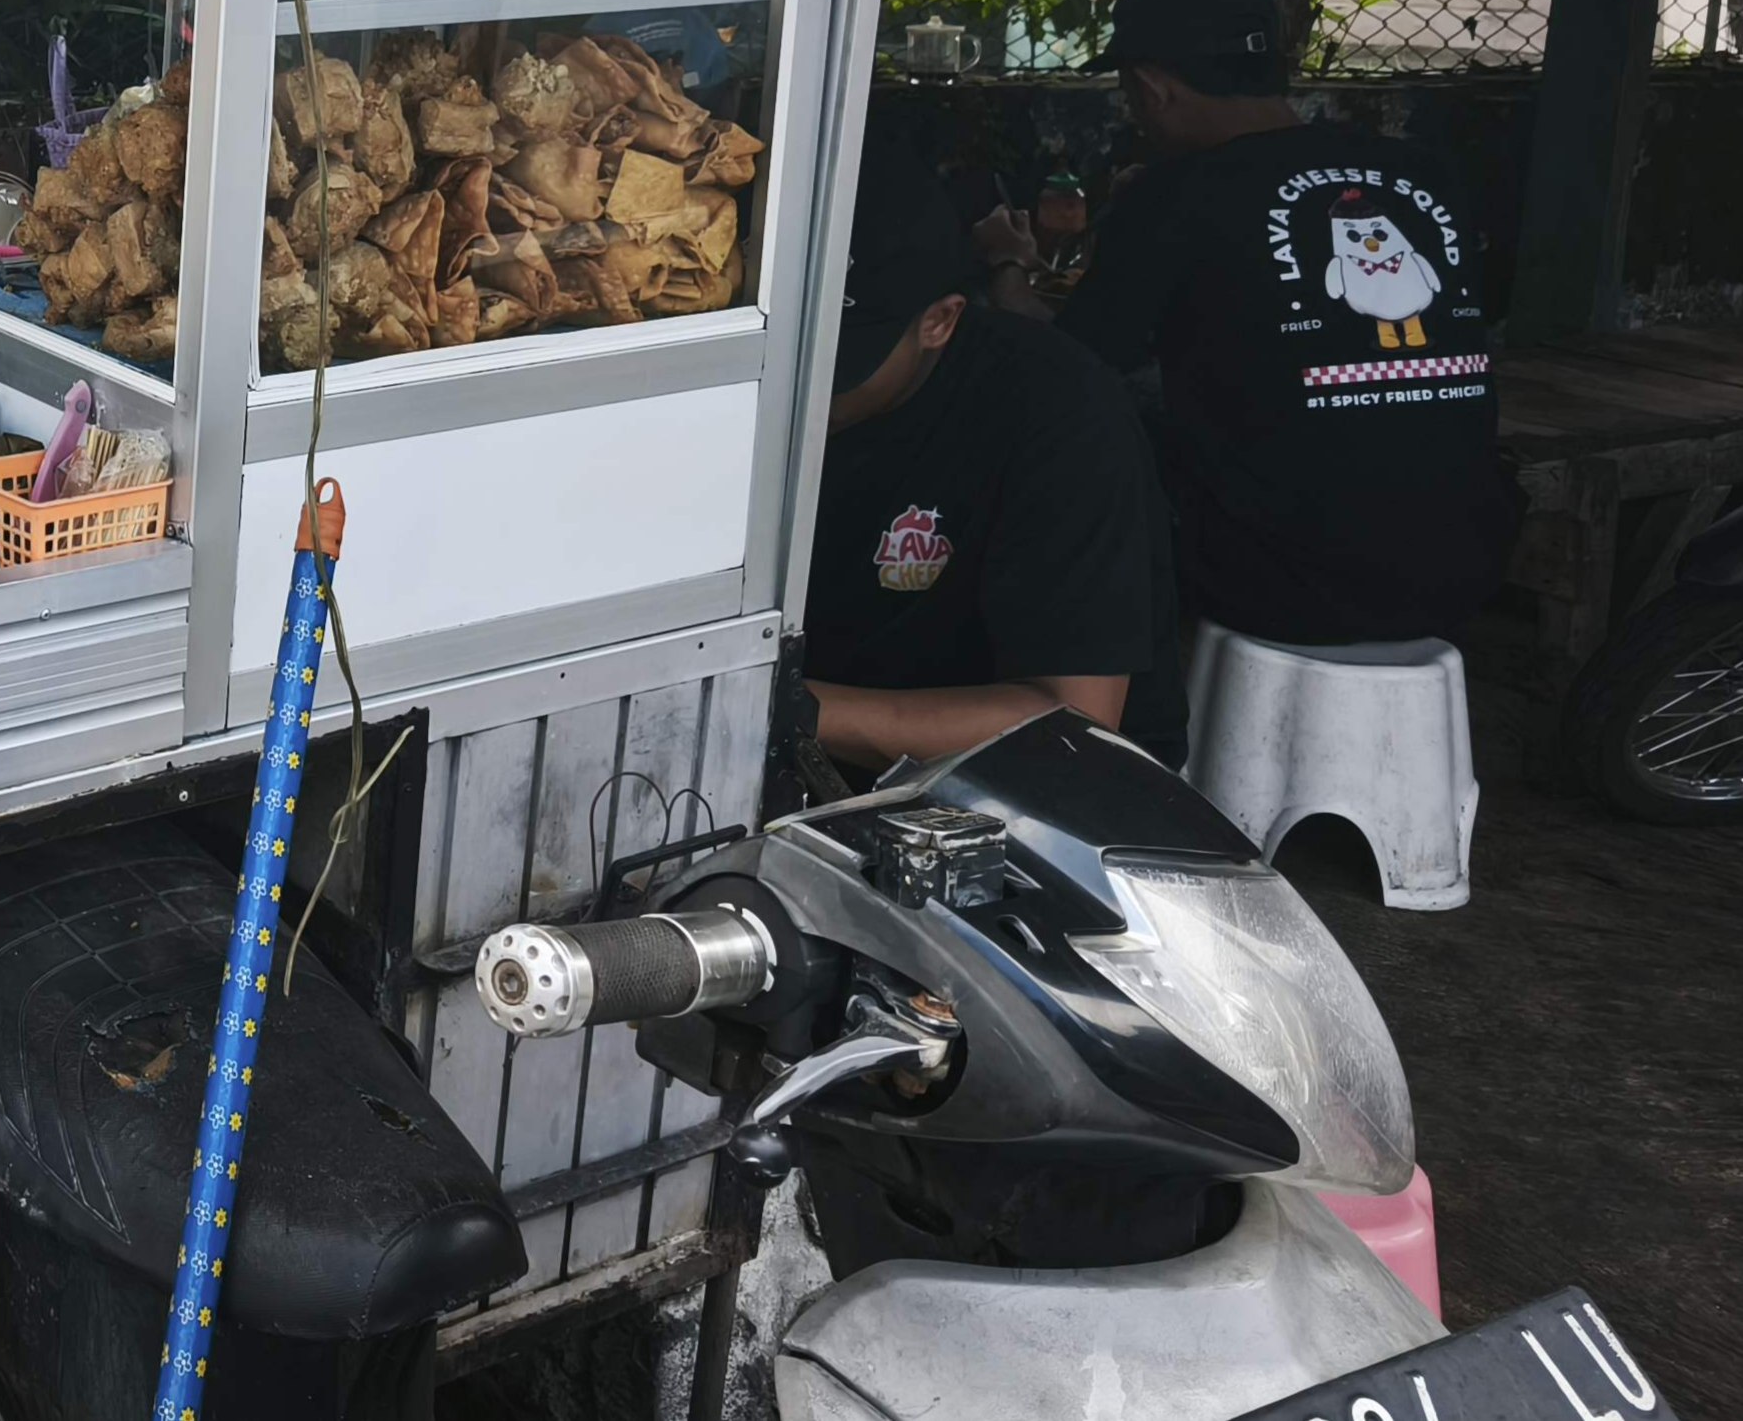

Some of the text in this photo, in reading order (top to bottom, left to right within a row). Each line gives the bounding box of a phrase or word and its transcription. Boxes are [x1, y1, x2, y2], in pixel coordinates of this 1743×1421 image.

[1267, 167, 1460, 281] LAVA CHEESE SQUAD
[1280, 318, 1323, 334] FRIED
[1331, 392, 1381, 408] SPICY
[1385, 389, 1433, 404] FRIED
[874, 531, 954, 563] LAVA
